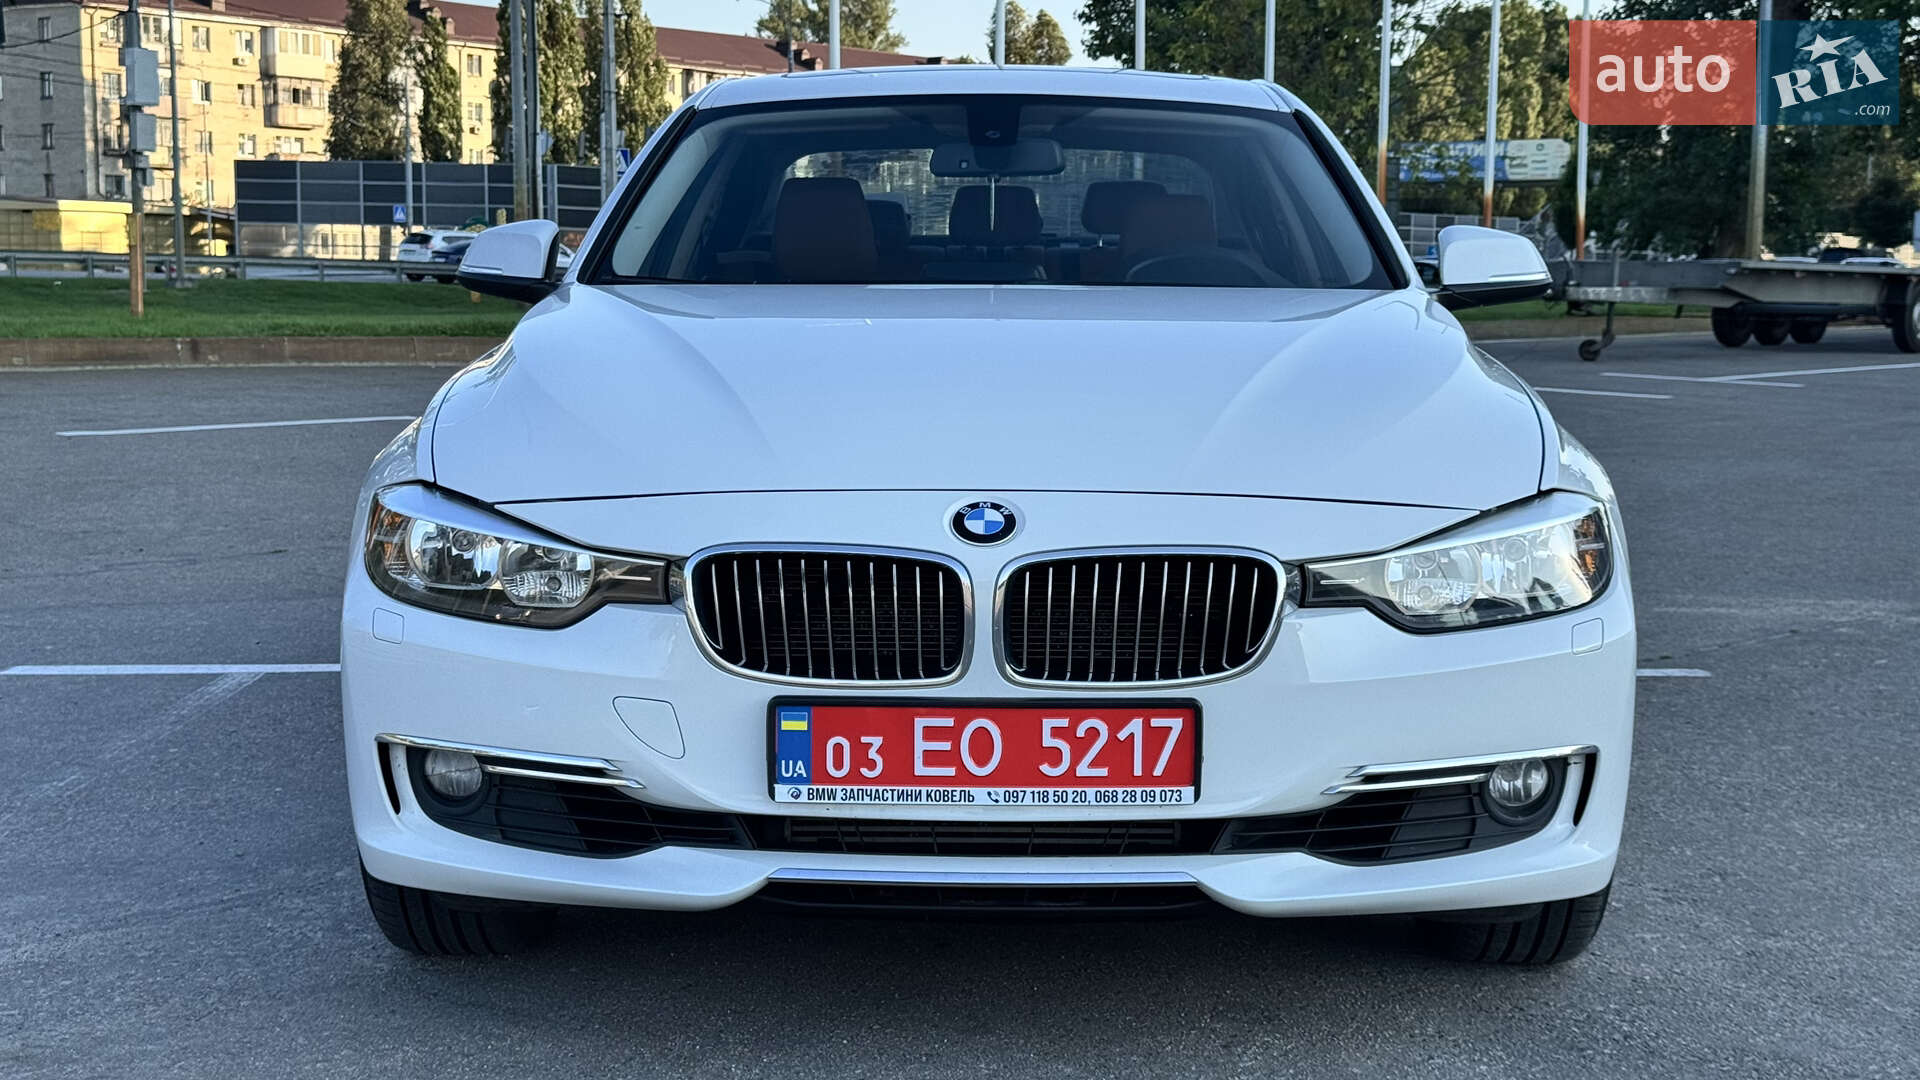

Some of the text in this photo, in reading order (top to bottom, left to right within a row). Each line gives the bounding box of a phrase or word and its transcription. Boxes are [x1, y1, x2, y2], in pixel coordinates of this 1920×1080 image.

[959, 502, 1012, 516] BMW
[826, 717, 1184, 779] 03 EO 5217
[781, 760, 807, 778] UA
[807, 787, 975, 803] BMW ЗАПЧАСТИНИ КОВЕЛЬ
[1003, 789, 1183, 806] 097 118 50 20, 068 28 09 073
